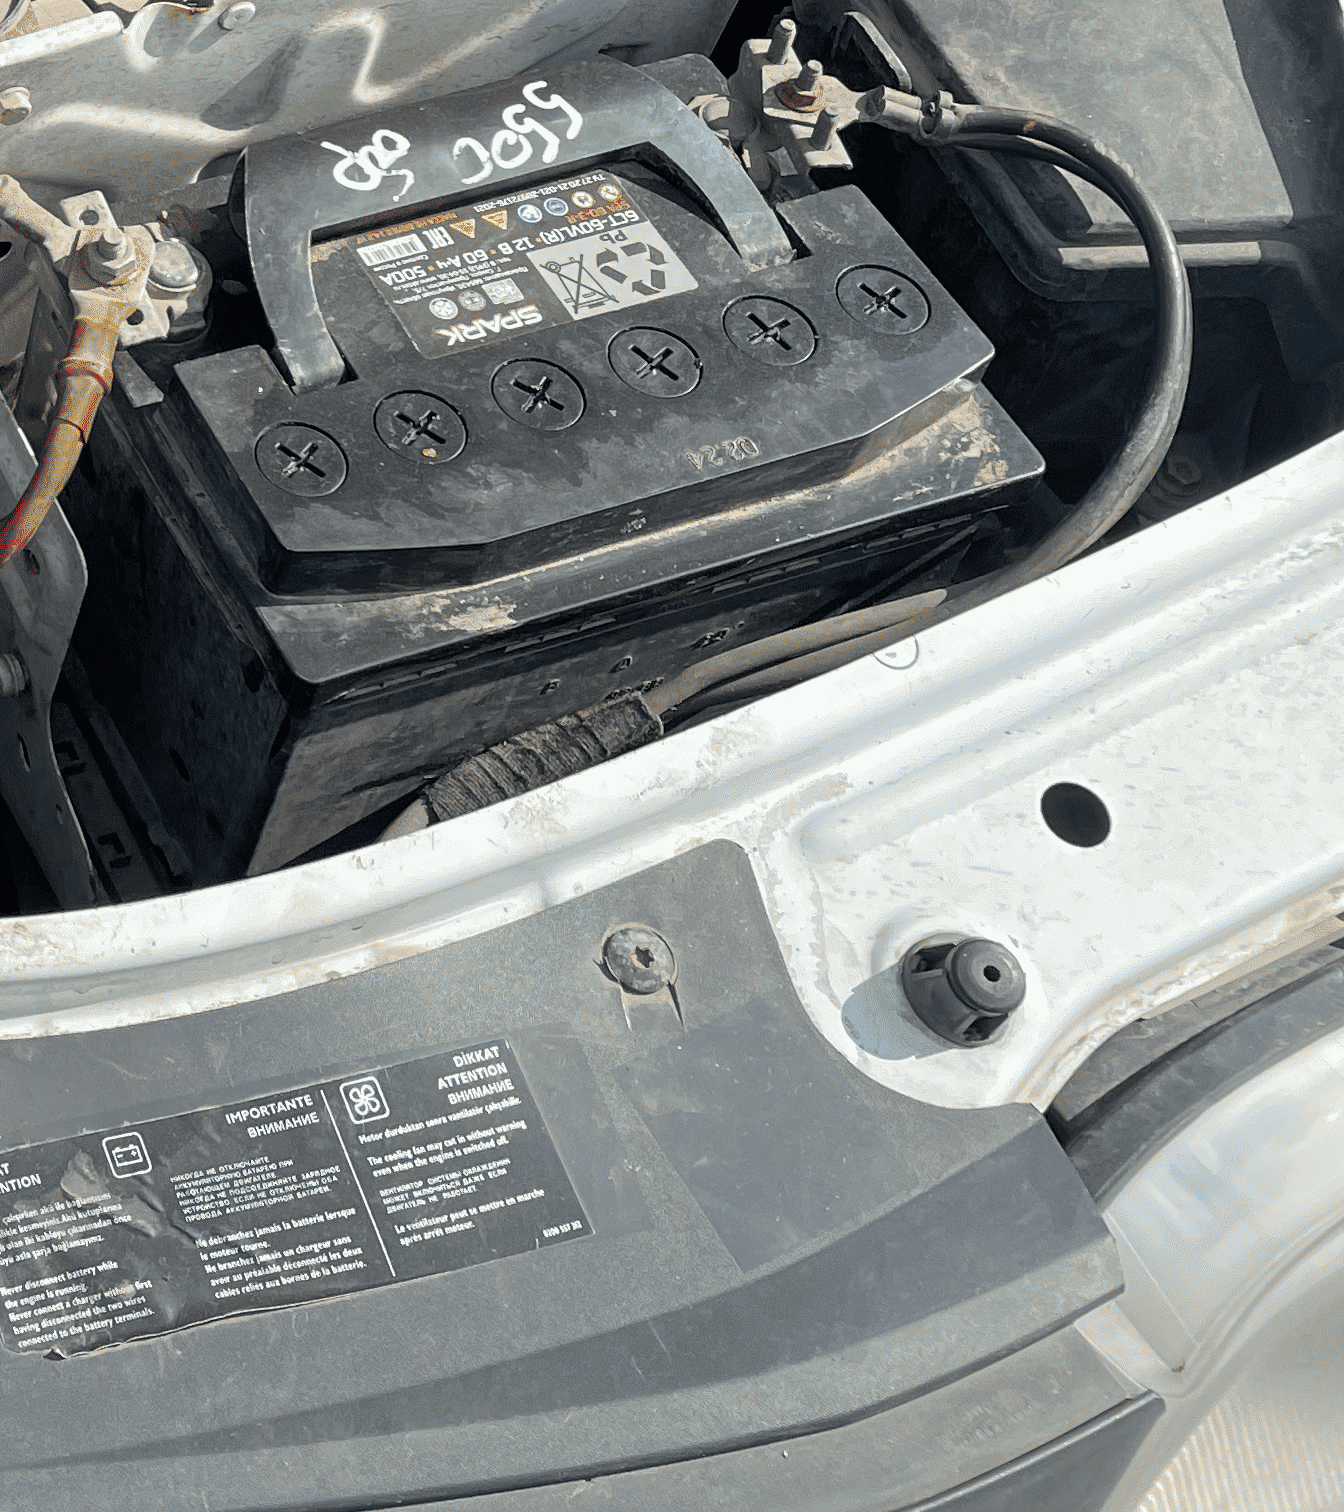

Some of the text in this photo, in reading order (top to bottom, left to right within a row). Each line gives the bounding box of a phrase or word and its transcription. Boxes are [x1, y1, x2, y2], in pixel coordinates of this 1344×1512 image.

[511, 236, 535, 251] 12
[598, 229, 629, 245] Pb
[462, 248, 489, 265] 60
[435, 304, 543, 346] SPARK
[438, 1061, 508, 1090] ATTENTION
[447, 1078, 515, 1105] ВНИМАНИЕ
[225, 1094, 314, 1125] IMPORTANTE
[246, 1111, 320, 1139] ВНИМАНИЕ
[0, 1260, 119, 1297] Never disconnect battery while
[4, 1299, 19, 1310] the
[19, 1293, 46, 1306] engine
[45, 1289, 55, 1299] is
[8, 1279, 153, 1323] Never connect a charger without first
[12, 1295, 147, 1335] having disconnected the two wires
[17, 1329, 59, 1349] connected
[58, 1329, 69, 1339] to
[68, 1325, 84, 1336] the
[83, 1318, 113, 1332] battery
